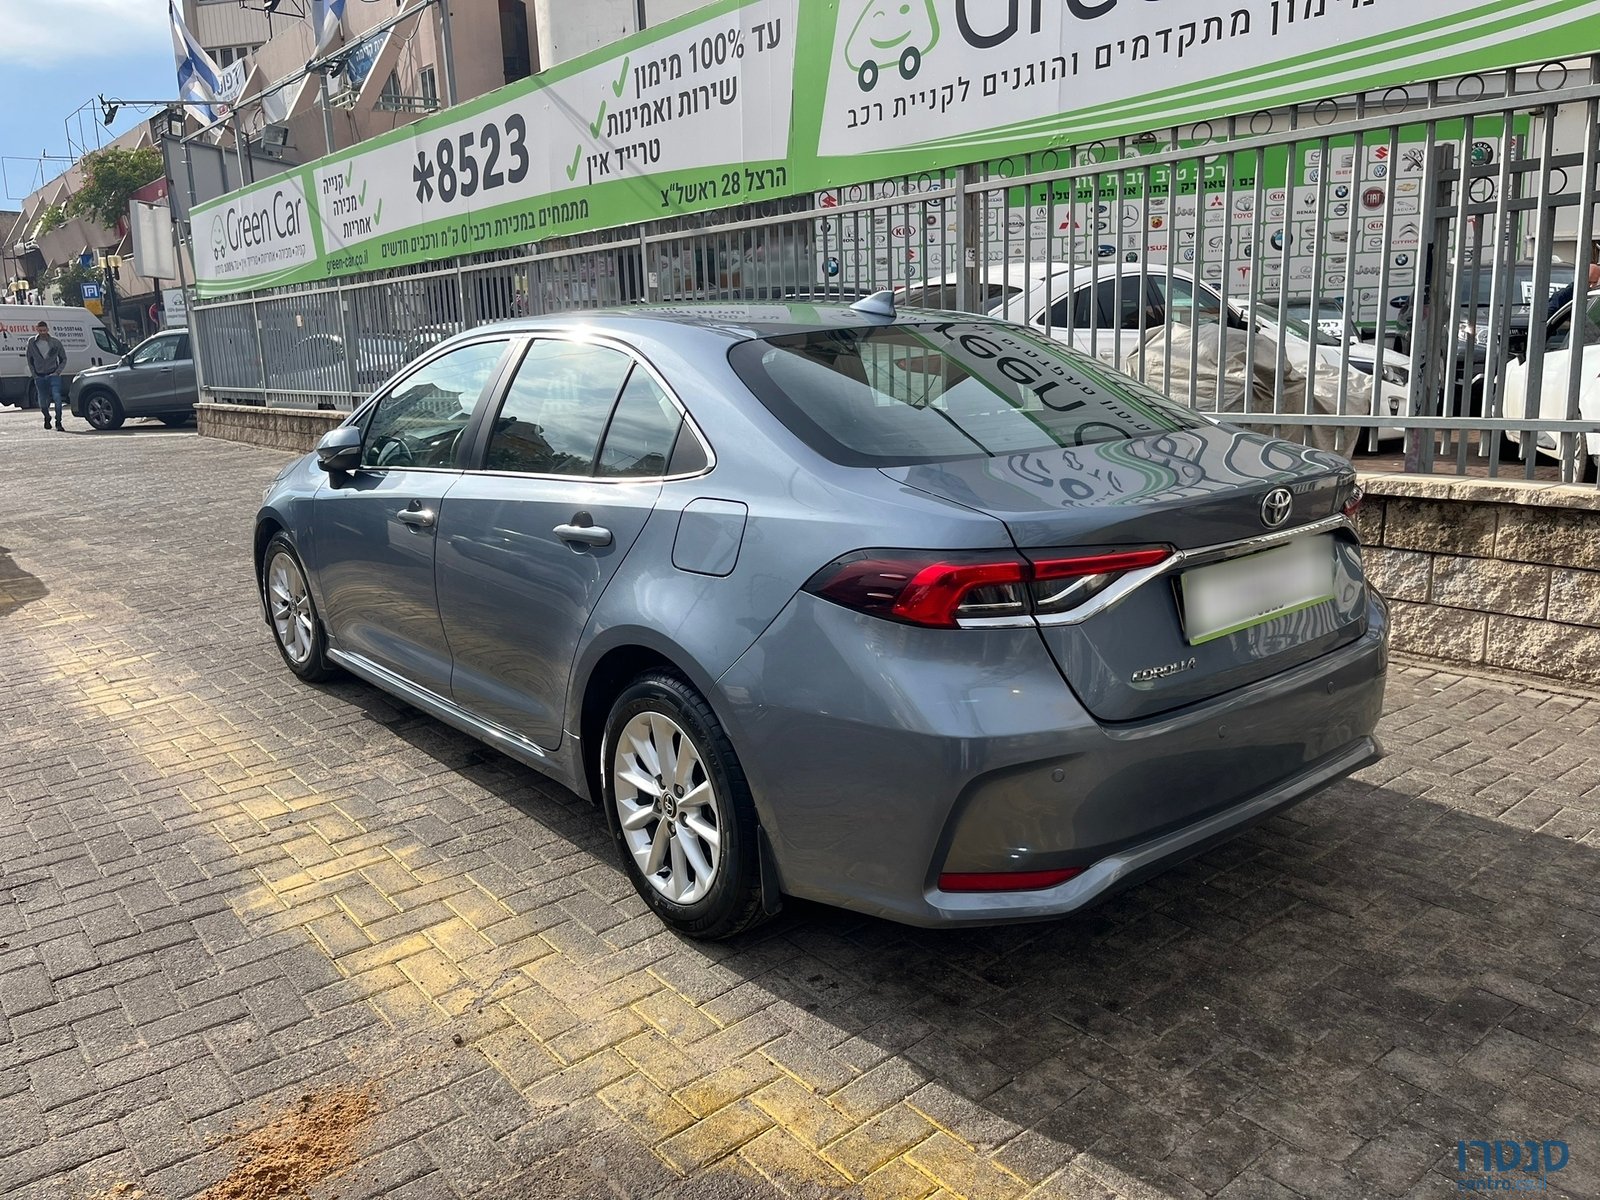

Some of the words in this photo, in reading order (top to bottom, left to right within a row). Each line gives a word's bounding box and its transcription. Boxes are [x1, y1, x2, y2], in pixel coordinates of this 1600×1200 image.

[751, 17, 782, 54] עד
[1095, 8, 1250, 70] מתקדמים
[688, 27, 745, 74] 100%
[633, 53, 683, 101] מימון
[983, 52, 1079, 97] והוגנים
[677, 75, 738, 118] שירות
[892, 76, 970, 119] לקניית
[606, 99, 673, 139] ואמינות
[847, 102, 883, 129] רכב
[614, 138, 661, 168] טרייד
[586, 152, 610, 187] אין
[745, 165, 787, 192] הרצל
[322, 173, 344, 195] קנייה
[721, 172, 740, 198] 28
[333, 194, 357, 216] מכירה
[1366, 194, 1380, 204] FIAT
[227, 208, 272, 251] Green
[273, 190, 301, 239] Car
[494, 212, 536, 237] במכירת
[538, 199, 589, 227] מתמחים
[343, 216, 372, 239] אחריות
[468, 219, 492, 241] רכבי
[381, 238, 409, 259] חדשים
[410, 231, 438, 252] ורכבים
[326, 249, 369, 275] green-car.co.il
[1130, 656, 1197, 683] COROLLA
